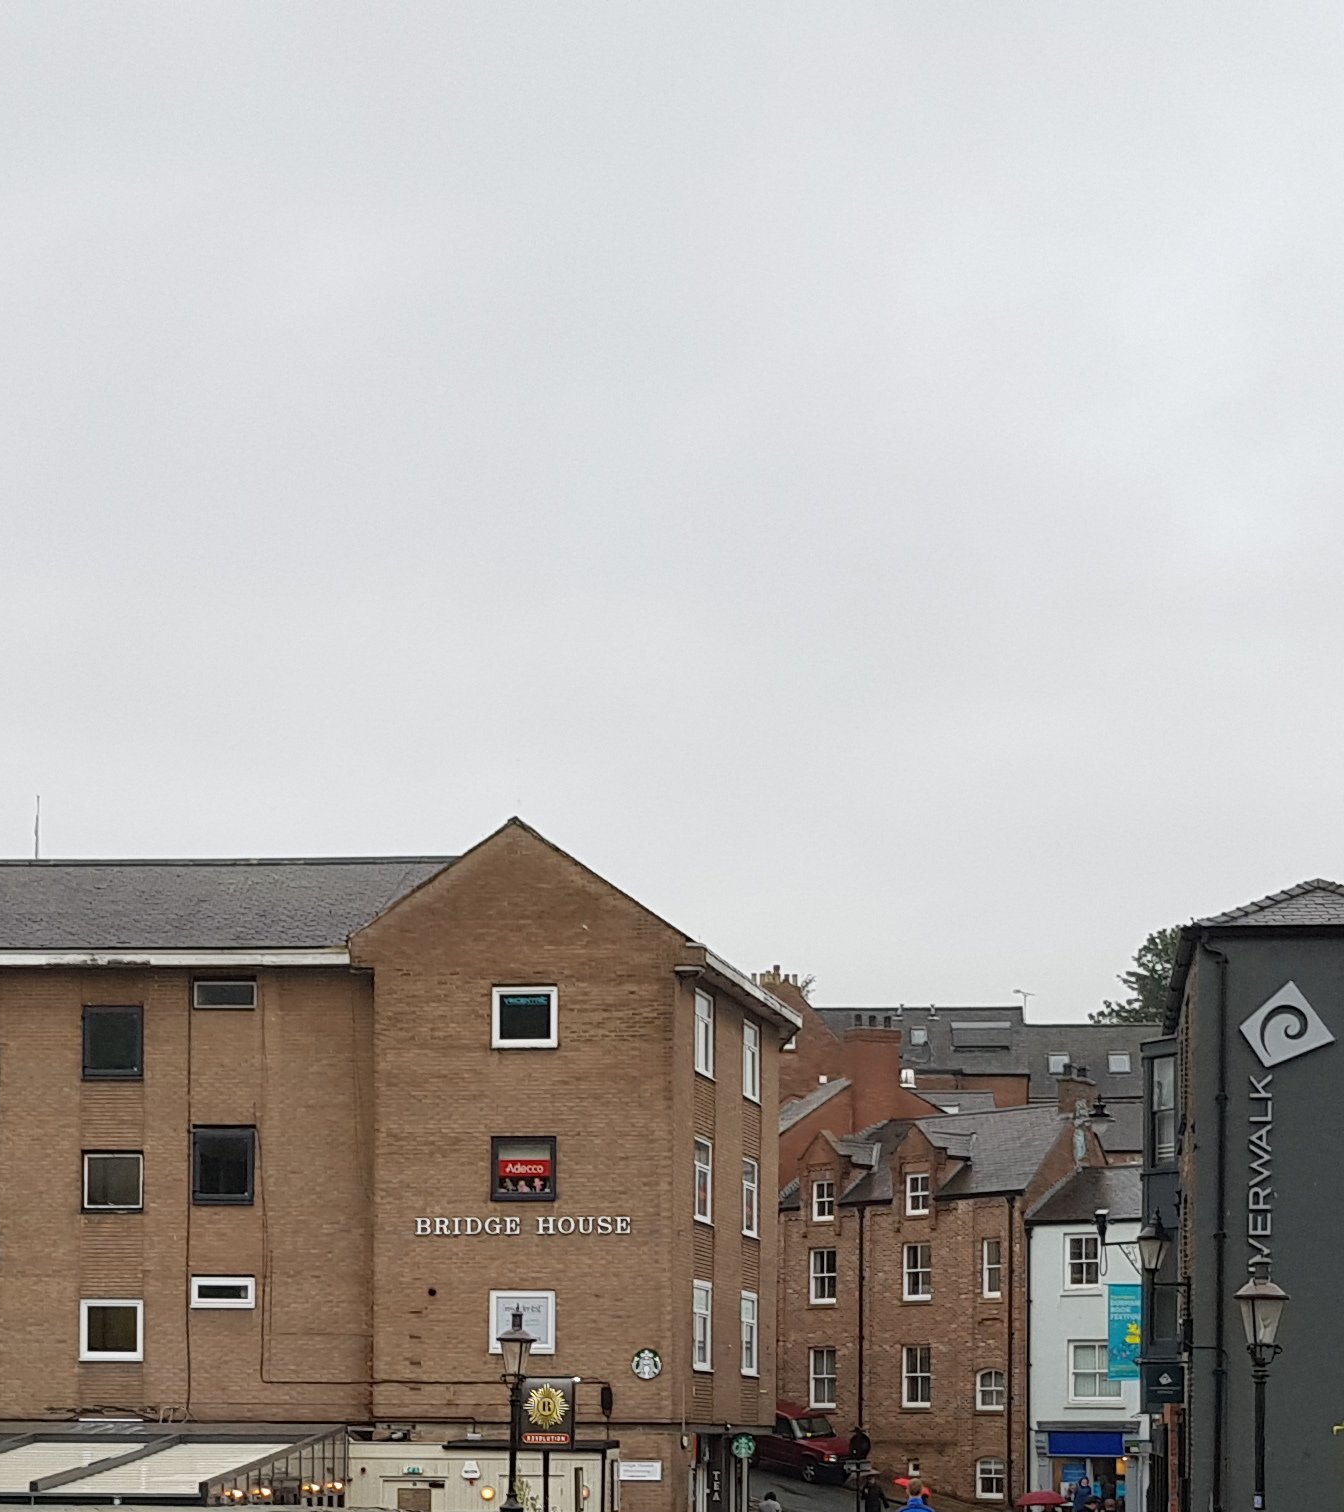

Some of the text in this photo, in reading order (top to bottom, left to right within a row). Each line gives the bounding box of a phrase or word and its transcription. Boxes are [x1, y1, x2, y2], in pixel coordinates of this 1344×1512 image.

[506, 1162, 544, 1173] Adecco
[1248, 1074, 1273, 1284] VERWALK
[414, 1216, 632, 1236] BRIDGE HOUSE
[712, 1471, 721, 1501] TEA
